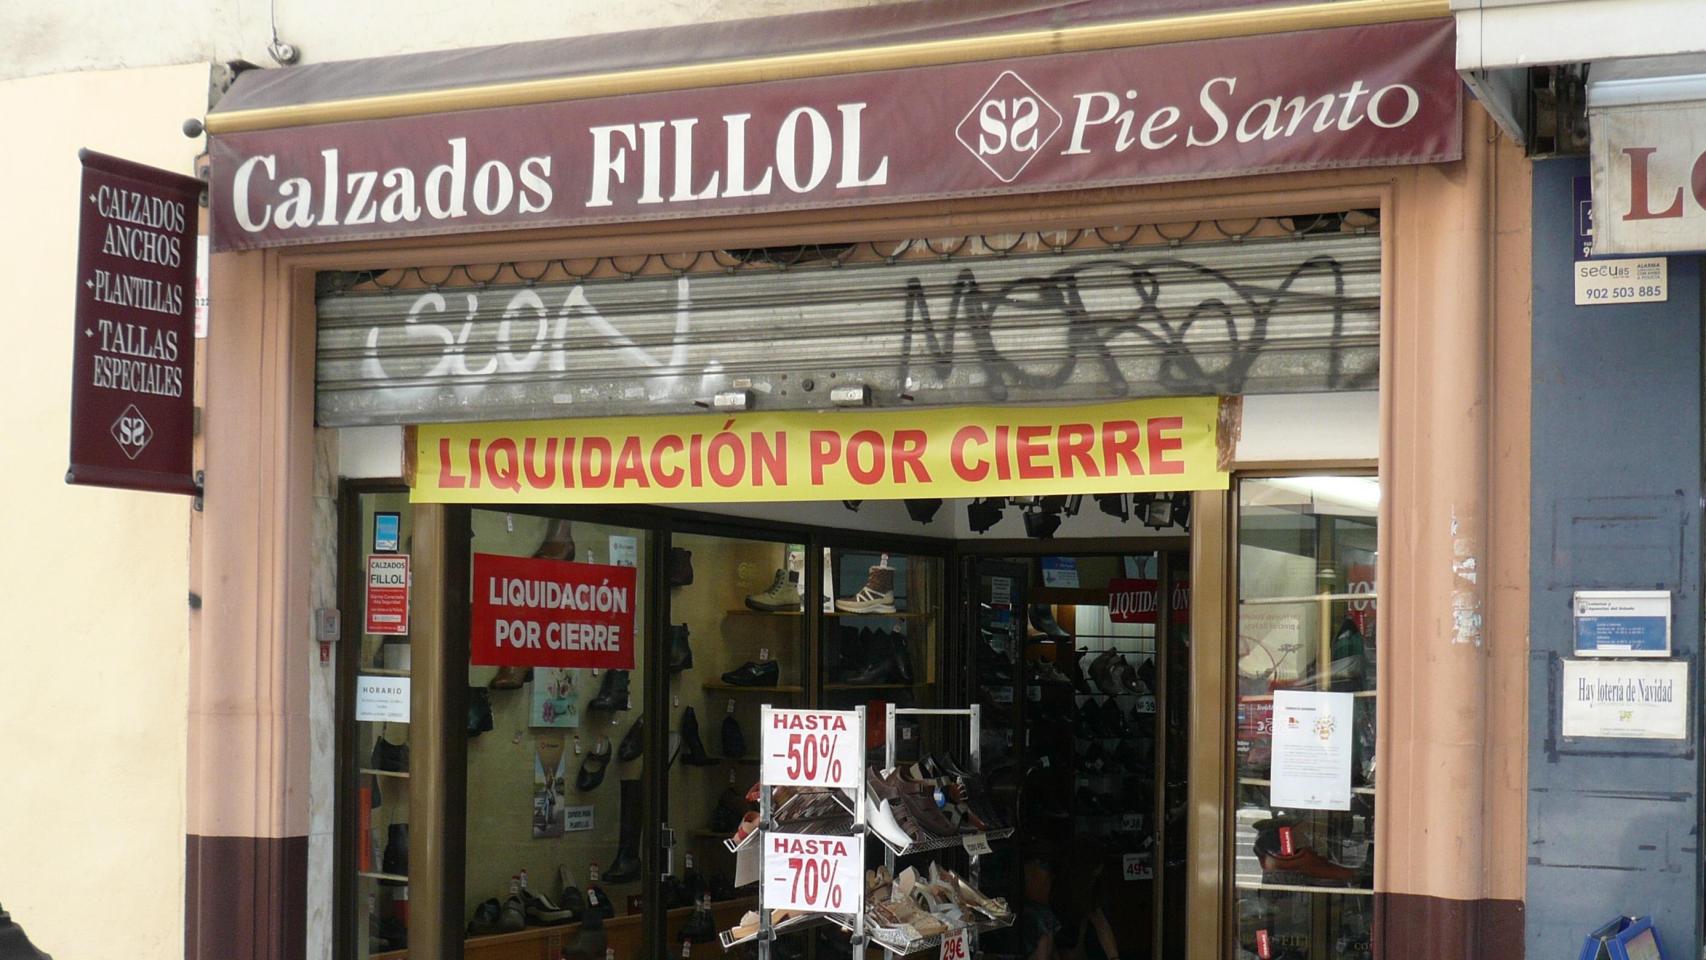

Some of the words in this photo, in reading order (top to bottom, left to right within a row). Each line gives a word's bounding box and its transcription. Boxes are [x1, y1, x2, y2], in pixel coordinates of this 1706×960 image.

[233, 137, 553, 232] Calzados
[585, 102, 888, 207] FILLOL
[1621, 146, 1706, 221] L
[98, 184, 185, 233] CALZADOS
[102, 222, 181, 268] ANCHOS
[94, 268, 183, 316] PLANTILLAS
[1586, 288, 1609, 299] 902
[1612, 287, 1635, 298] 503
[1638, 285, 1662, 297] 885
[98, 319, 178, 362] TALLAS
[93, 354, 183, 398] ESPECIALES
[438, 419, 787, 494] LIQUIDACIÓN
[809, 429, 933, 486] POR
[950, 416, 1185, 482] CIERRE
[370, 561, 406, 569] CALZADOS
[370, 574, 405, 585] FILLOL
[489, 577, 627, 614] LIQUIDACIÓN
[495, 619, 541, 649] POR
[545, 621, 620, 652] CIERRE
[363, 686, 402, 695] HORARIO
[1578, 677, 1595, 708] Hay
[1597, 676, 1624, 702] lotería
[1626, 677, 1636, 702] de
[1638, 677, 1673, 703] Navidad
[773, 714, 847, 731] HASTA
[773, 734, 842, 783] -50%
[774, 838, 847, 857] HASTA
[774, 858, 842, 908] -70%
[943, 936, 965, 960] 29€
